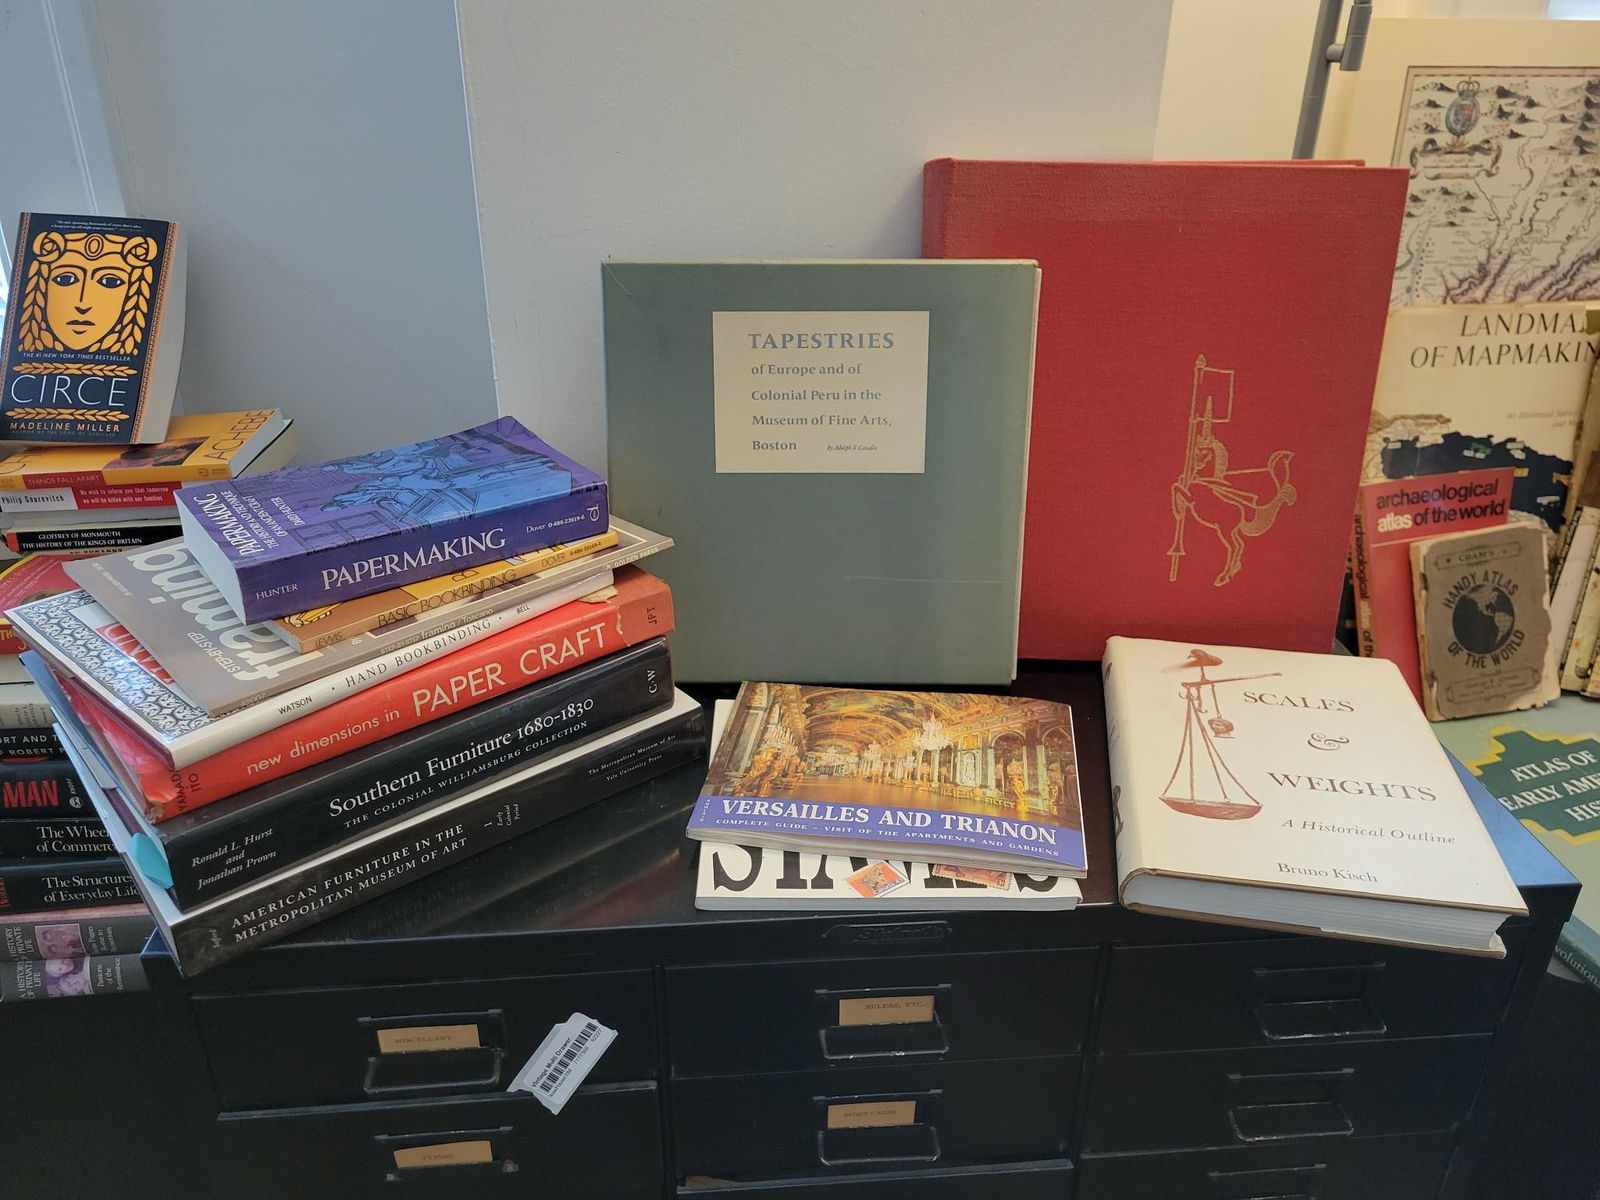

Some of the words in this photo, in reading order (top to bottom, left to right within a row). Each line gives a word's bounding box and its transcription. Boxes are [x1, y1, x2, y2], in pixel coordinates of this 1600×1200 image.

[748, 332, 894, 349] TAPESTRIES
[751, 364, 765, 375] of
[768, 364, 816, 377] Europe
[819, 364, 844, 375] and
[848, 363, 863, 375] of
[1410, 346, 1447, 368] OF
[11, 374, 129, 407] CIRCE
[751, 390, 807, 401] Colonial
[811, 390, 840, 401] Peru
[844, 390, 857, 401] in
[860, 389, 882, 401] the
[10, 422, 70, 432] MADELINE
[77, 423, 120, 433] MILLER
[203, 409, 275, 460] ACHEBE
[752, 415, 808, 426] Museum
[811, 415, 827, 426] of
[828, 415, 857, 426] Fine
[860, 415, 892, 427] Arts,
[752, 440, 797, 451] Boston
[28, 478, 54, 486] THINGS
[55, 477, 73, 485] FALL
[75, 475, 100, 483] APART
[1376, 479, 1498, 509] archaeological
[2, 496, 22, 504] Philip
[25, 494, 65, 504] Gourevitch
[193, 493, 265, 556] PAPERMAKING
[1377, 512, 1413, 533] atlas
[1413, 508, 1430, 527] of
[1432, 506, 1457, 523] the
[1459, 500, 1505, 522] world
[36, 541, 63, 549] HISTORY
[88, 539, 107, 547] KINGS
[256, 583, 298, 600] HUNTER
[321, 528, 506, 591] PAPERMAKING
[526, 523, 545, 534] Dover
[614, 555, 639, 569] GOLDEN
[377, 603, 418, 628] BASIC
[420, 569, 517, 612] BOOKBINDING
[541, 551, 567, 568] DOVER
[1442, 570, 1477, 609] HANDY
[1483, 570, 1519, 597] ATLAS
[648, 605, 658, 626] JPT
[187, 631, 242, 674] STEP-BY-STEP
[278, 695, 313, 716] WATSON
[345, 663, 388, 688] HAND
[394, 618, 492, 667] BOOKBINDING
[516, 603, 531, 616] BELL
[1448, 640, 1464, 659] OF
[1465, 652, 1488, 669] THE
[1490, 628, 1525, 667] WORLD
[247, 753, 282, 775] new
[290, 715, 380, 759] dimensions
[384, 708, 400, 724] in
[412, 662, 506, 718] PAPER
[519, 622, 606, 677] CRAFT
[1243, 690, 1355, 713] SCALES
[9, 748, 54, 756] ROBERT
[23, 735, 47, 743] AND
[637, 742, 659, 754] Museum
[1307, 732, 1350, 751] &
[329, 771, 421, 817] Southern
[425, 731, 512, 777] Furniture
[516, 699, 594, 744] 1680-1830
[1510, 757, 1571, 783] ATLAS
[1567, 749, 1599, 767] OF
[189, 772, 201, 794] ITO
[344, 813, 369, 829] THE
[374, 787, 434, 816] COLONIAL
[438, 749, 521, 789] WILLIAMSBURG
[525, 721, 588, 752] COLLECTION
[1267, 771, 1437, 802] WEIGHTS
[3, 780, 59, 808] MAN
[1498, 784, 1564, 811] EARLY
[36, 825, 64, 839] The
[722, 800, 870, 823] VERSAILLES
[878, 810, 932, 828] AND
[941, 814, 1057, 845] TRIANON
[1282, 818, 1294, 828] A
[1302, 820, 1384, 838] Historical
[1390, 829, 1456, 844] Outline
[36, 840, 49, 853] of
[192, 844, 228, 868] Ronald
[231, 841, 242, 851] L.
[244, 828, 273, 846] Hurst
[715, 819, 770, 828] COMPLETE
[776, 822, 808, 831] GUIDE
[905, 831, 976, 844] APARTMENTS
[981, 839, 1004, 847] AND
[1008, 843, 1060, 857] GARDENS
[197, 864, 243, 891] Jonathan
[246, 851, 277, 868] Prown
[225, 850, 245, 865] and
[42, 876, 71, 889] The
[232, 885, 318, 929] AMERICAN
[324, 847, 410, 890] FURNITURE
[415, 838, 431, 852] IN
[435, 824, 464, 842] THE
[1277, 862, 1328, 878] Bruno
[1332, 868, 1379, 884] Kisch
[44, 890, 57, 903] of
[60, 888, 114, 902] Everyday
[235, 886, 353, 943] METROPOLITAN
[358, 859, 417, 892] MUSEUM
[421, 850, 438, 864] OF
[442, 838, 467, 856] ART
[5, 927, 17, 957] HISTORY
[14, 926, 26, 957] PRIVATE
[25, 939, 34, 953] LIFE
[531, 1068, 548, 1088] Vintage
[546, 1056, 557, 1069] Multi
[554, 1037, 571, 1056] Drawer
